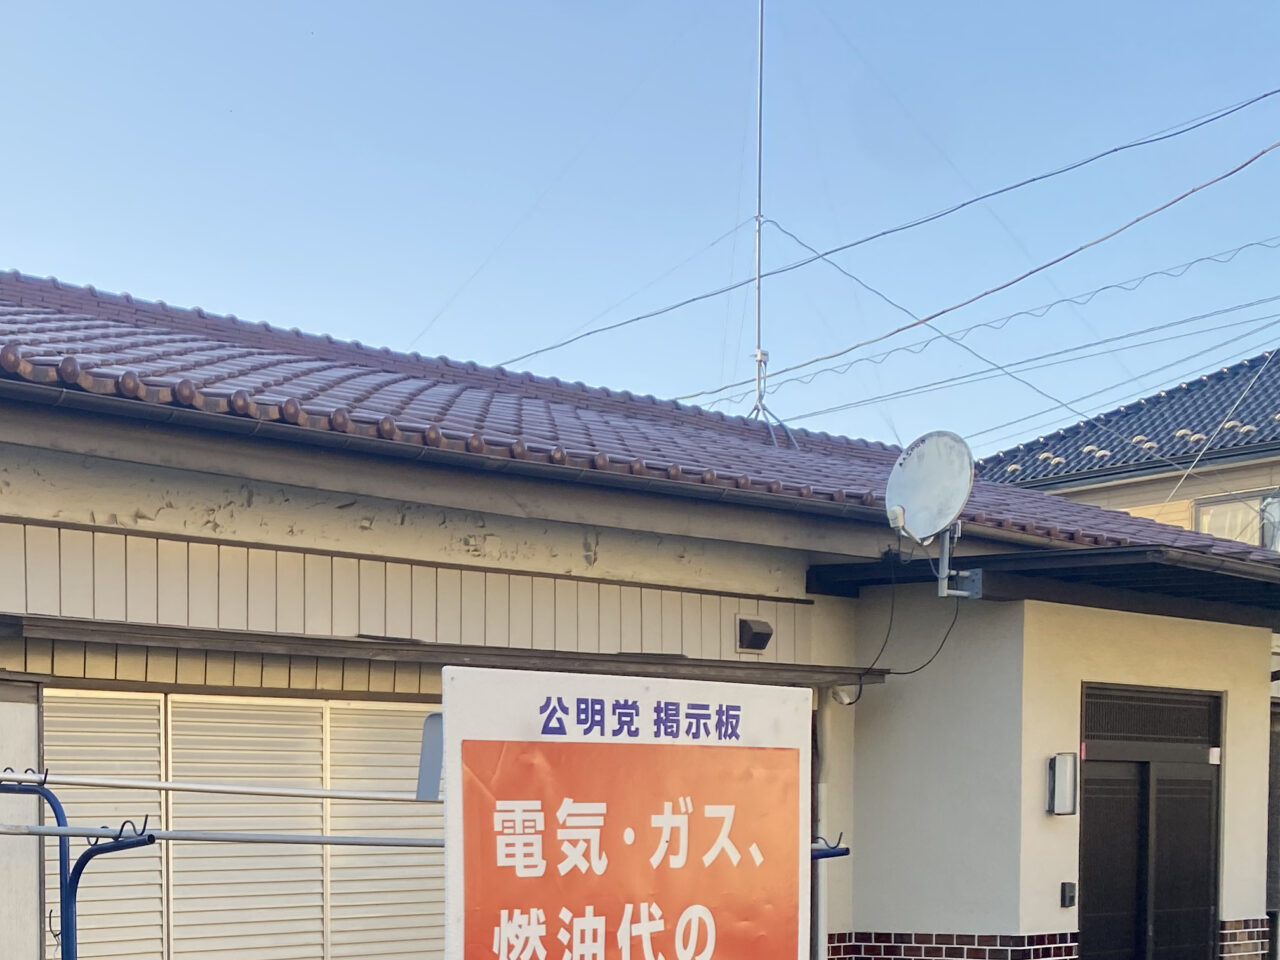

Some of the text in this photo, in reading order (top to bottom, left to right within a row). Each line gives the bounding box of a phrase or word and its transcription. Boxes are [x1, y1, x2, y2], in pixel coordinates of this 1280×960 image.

[538, 696, 742, 741] 公明党 掲示板
[493, 796, 764, 878] 電気・ガス、
